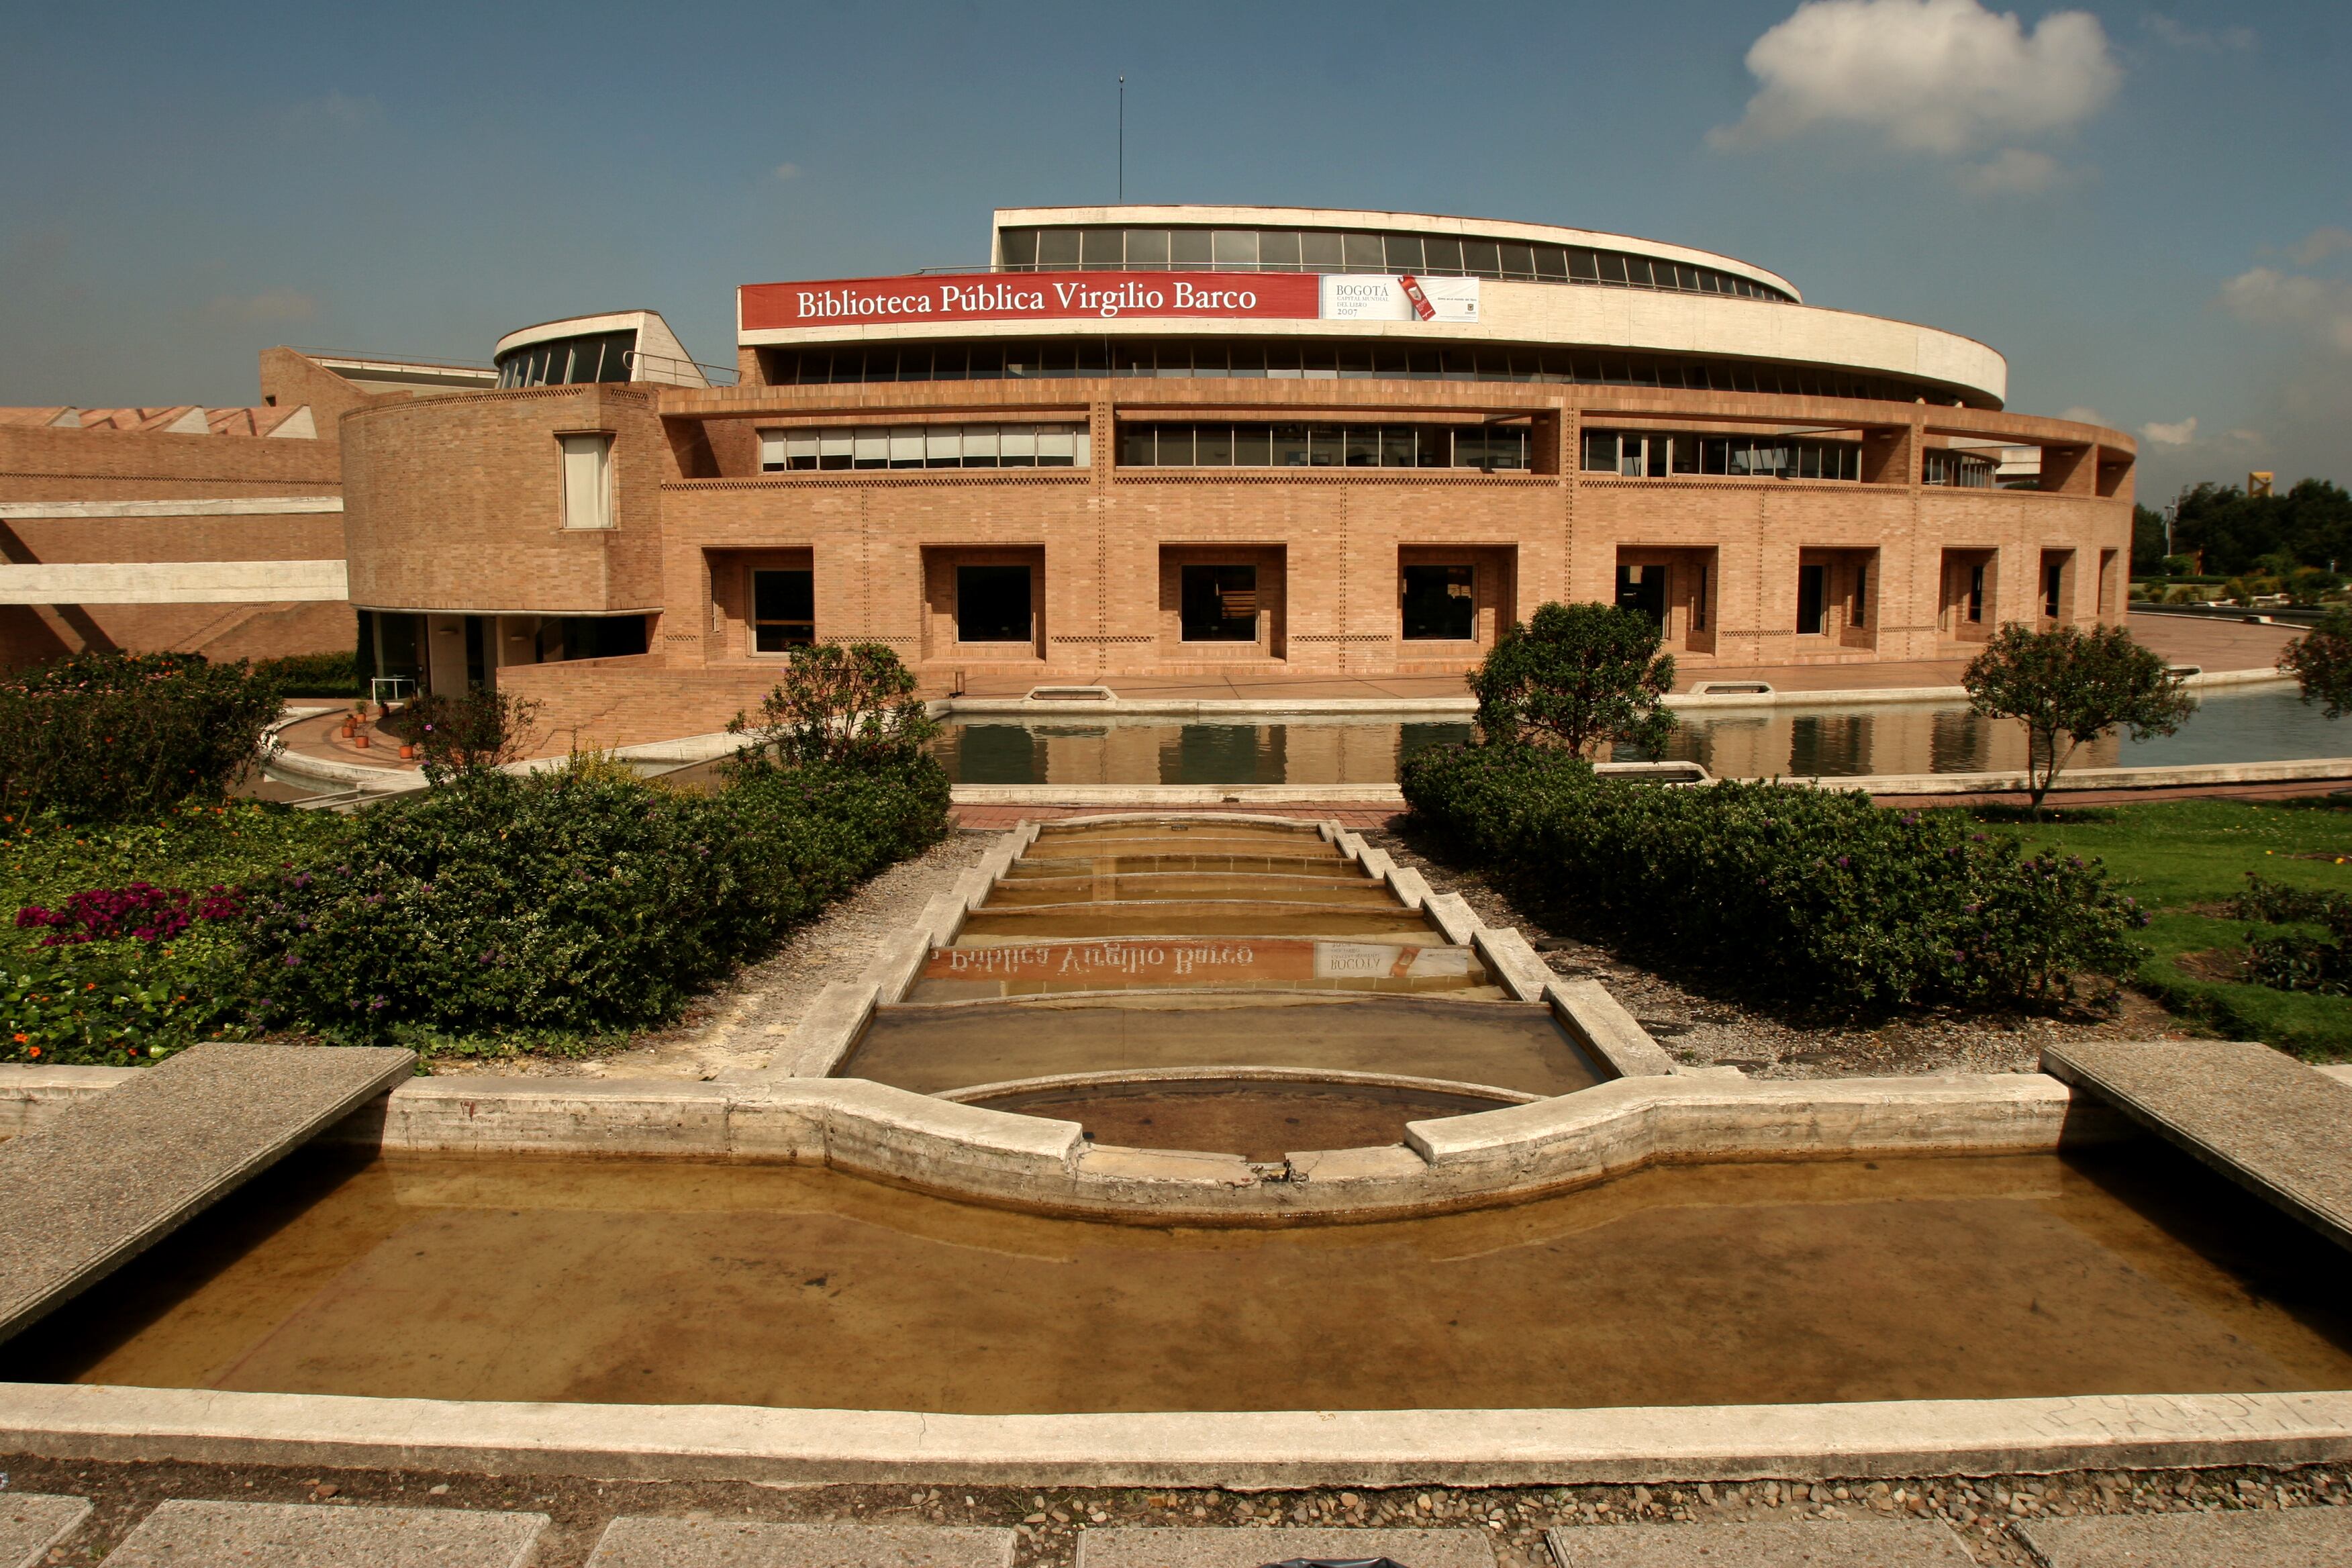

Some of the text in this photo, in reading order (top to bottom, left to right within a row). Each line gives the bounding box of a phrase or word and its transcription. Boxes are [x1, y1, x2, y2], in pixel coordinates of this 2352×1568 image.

[1336, 283, 1389, 296] BOGOTÁ
[797, 281, 1257, 317] Biblioteca Pública Virgilio Barco
[1337, 309, 1357, 317] 2007
